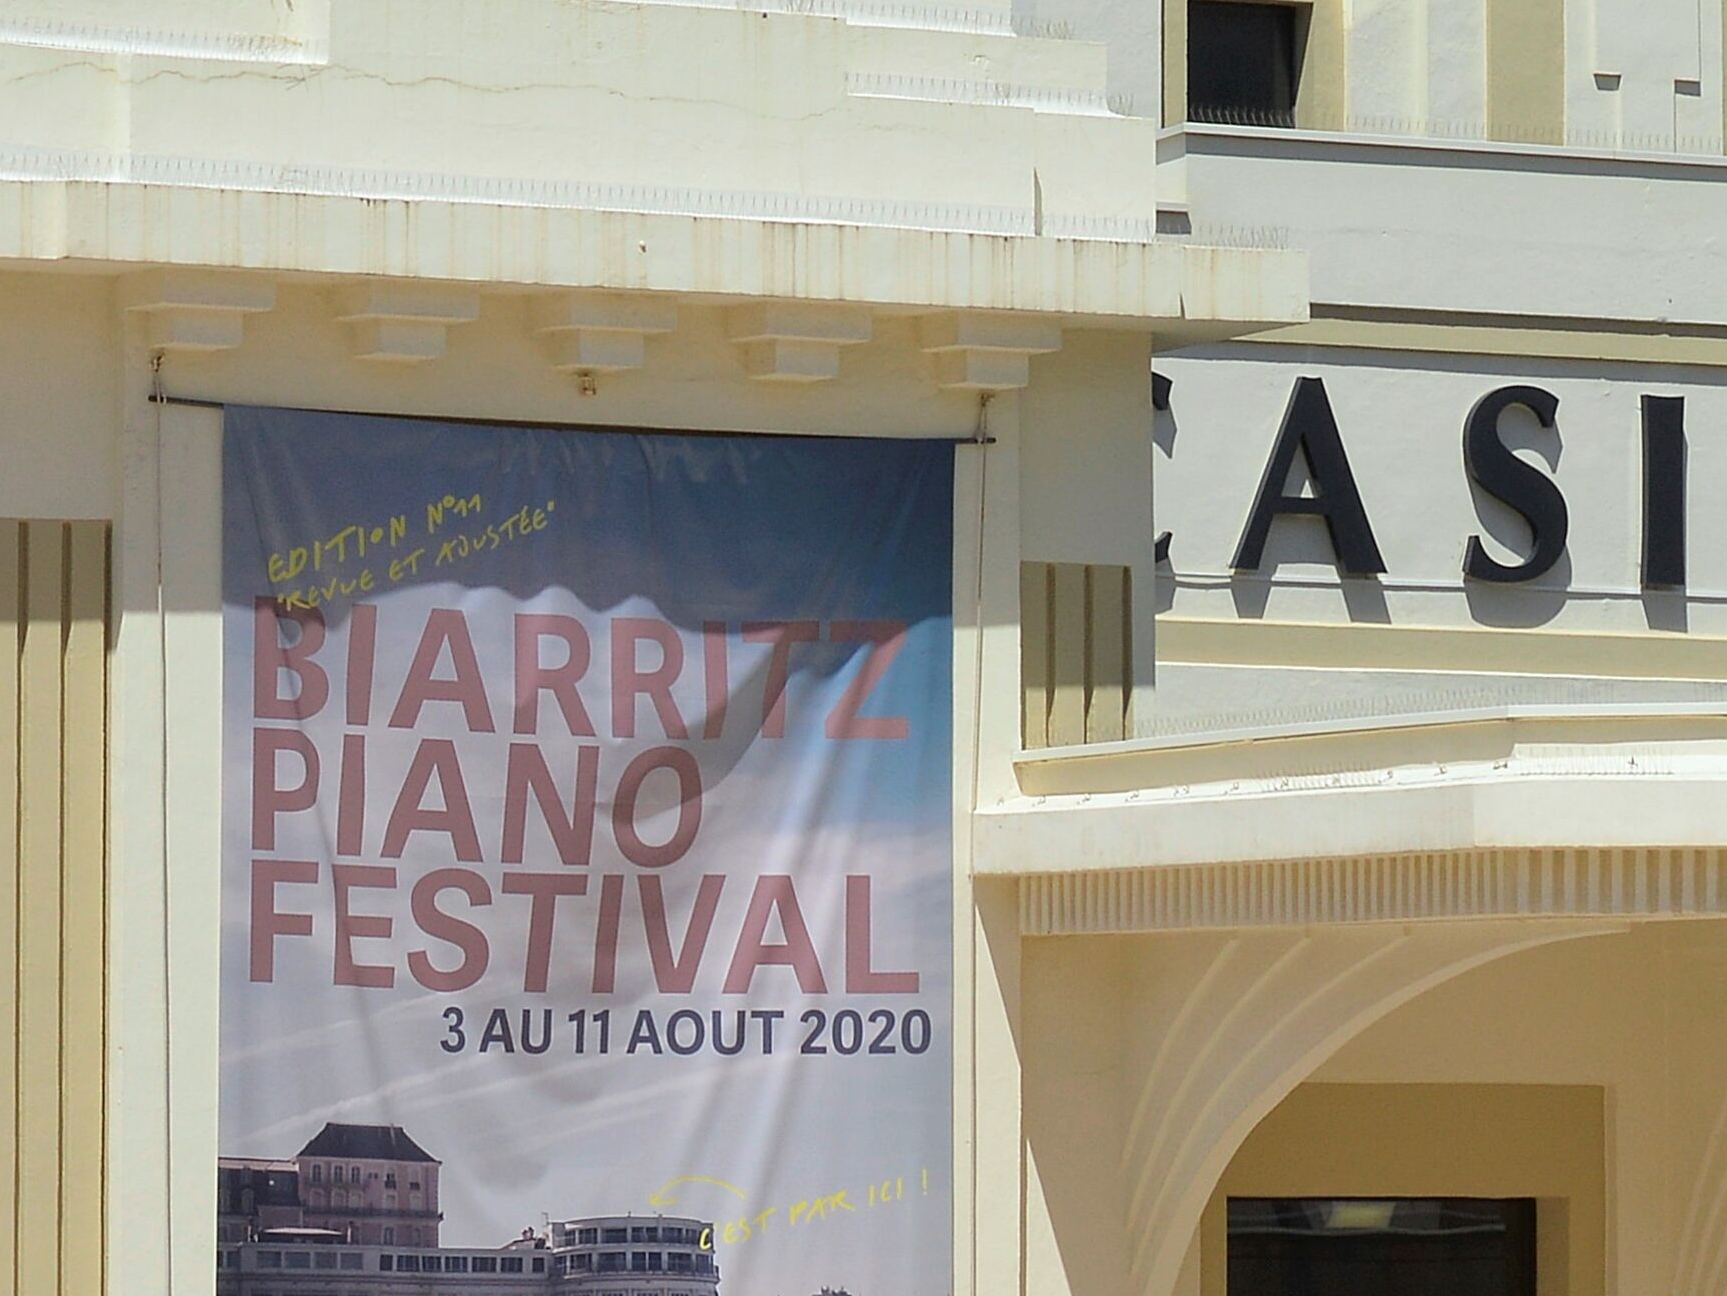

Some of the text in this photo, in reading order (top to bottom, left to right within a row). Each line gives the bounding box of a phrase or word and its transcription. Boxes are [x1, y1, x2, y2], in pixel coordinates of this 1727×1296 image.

[268, 515, 405, 582] EDITION
[389, 549, 425, 581] ET
[254, 596, 909, 739] BIARRITZ
[252, 726, 704, 867] PIANO
[250, 859, 920, 994] FESTIVAL
[441, 1007, 931, 1055] 3 AU 11 AOUT 2020
[789, 1191, 855, 1225] PAR
